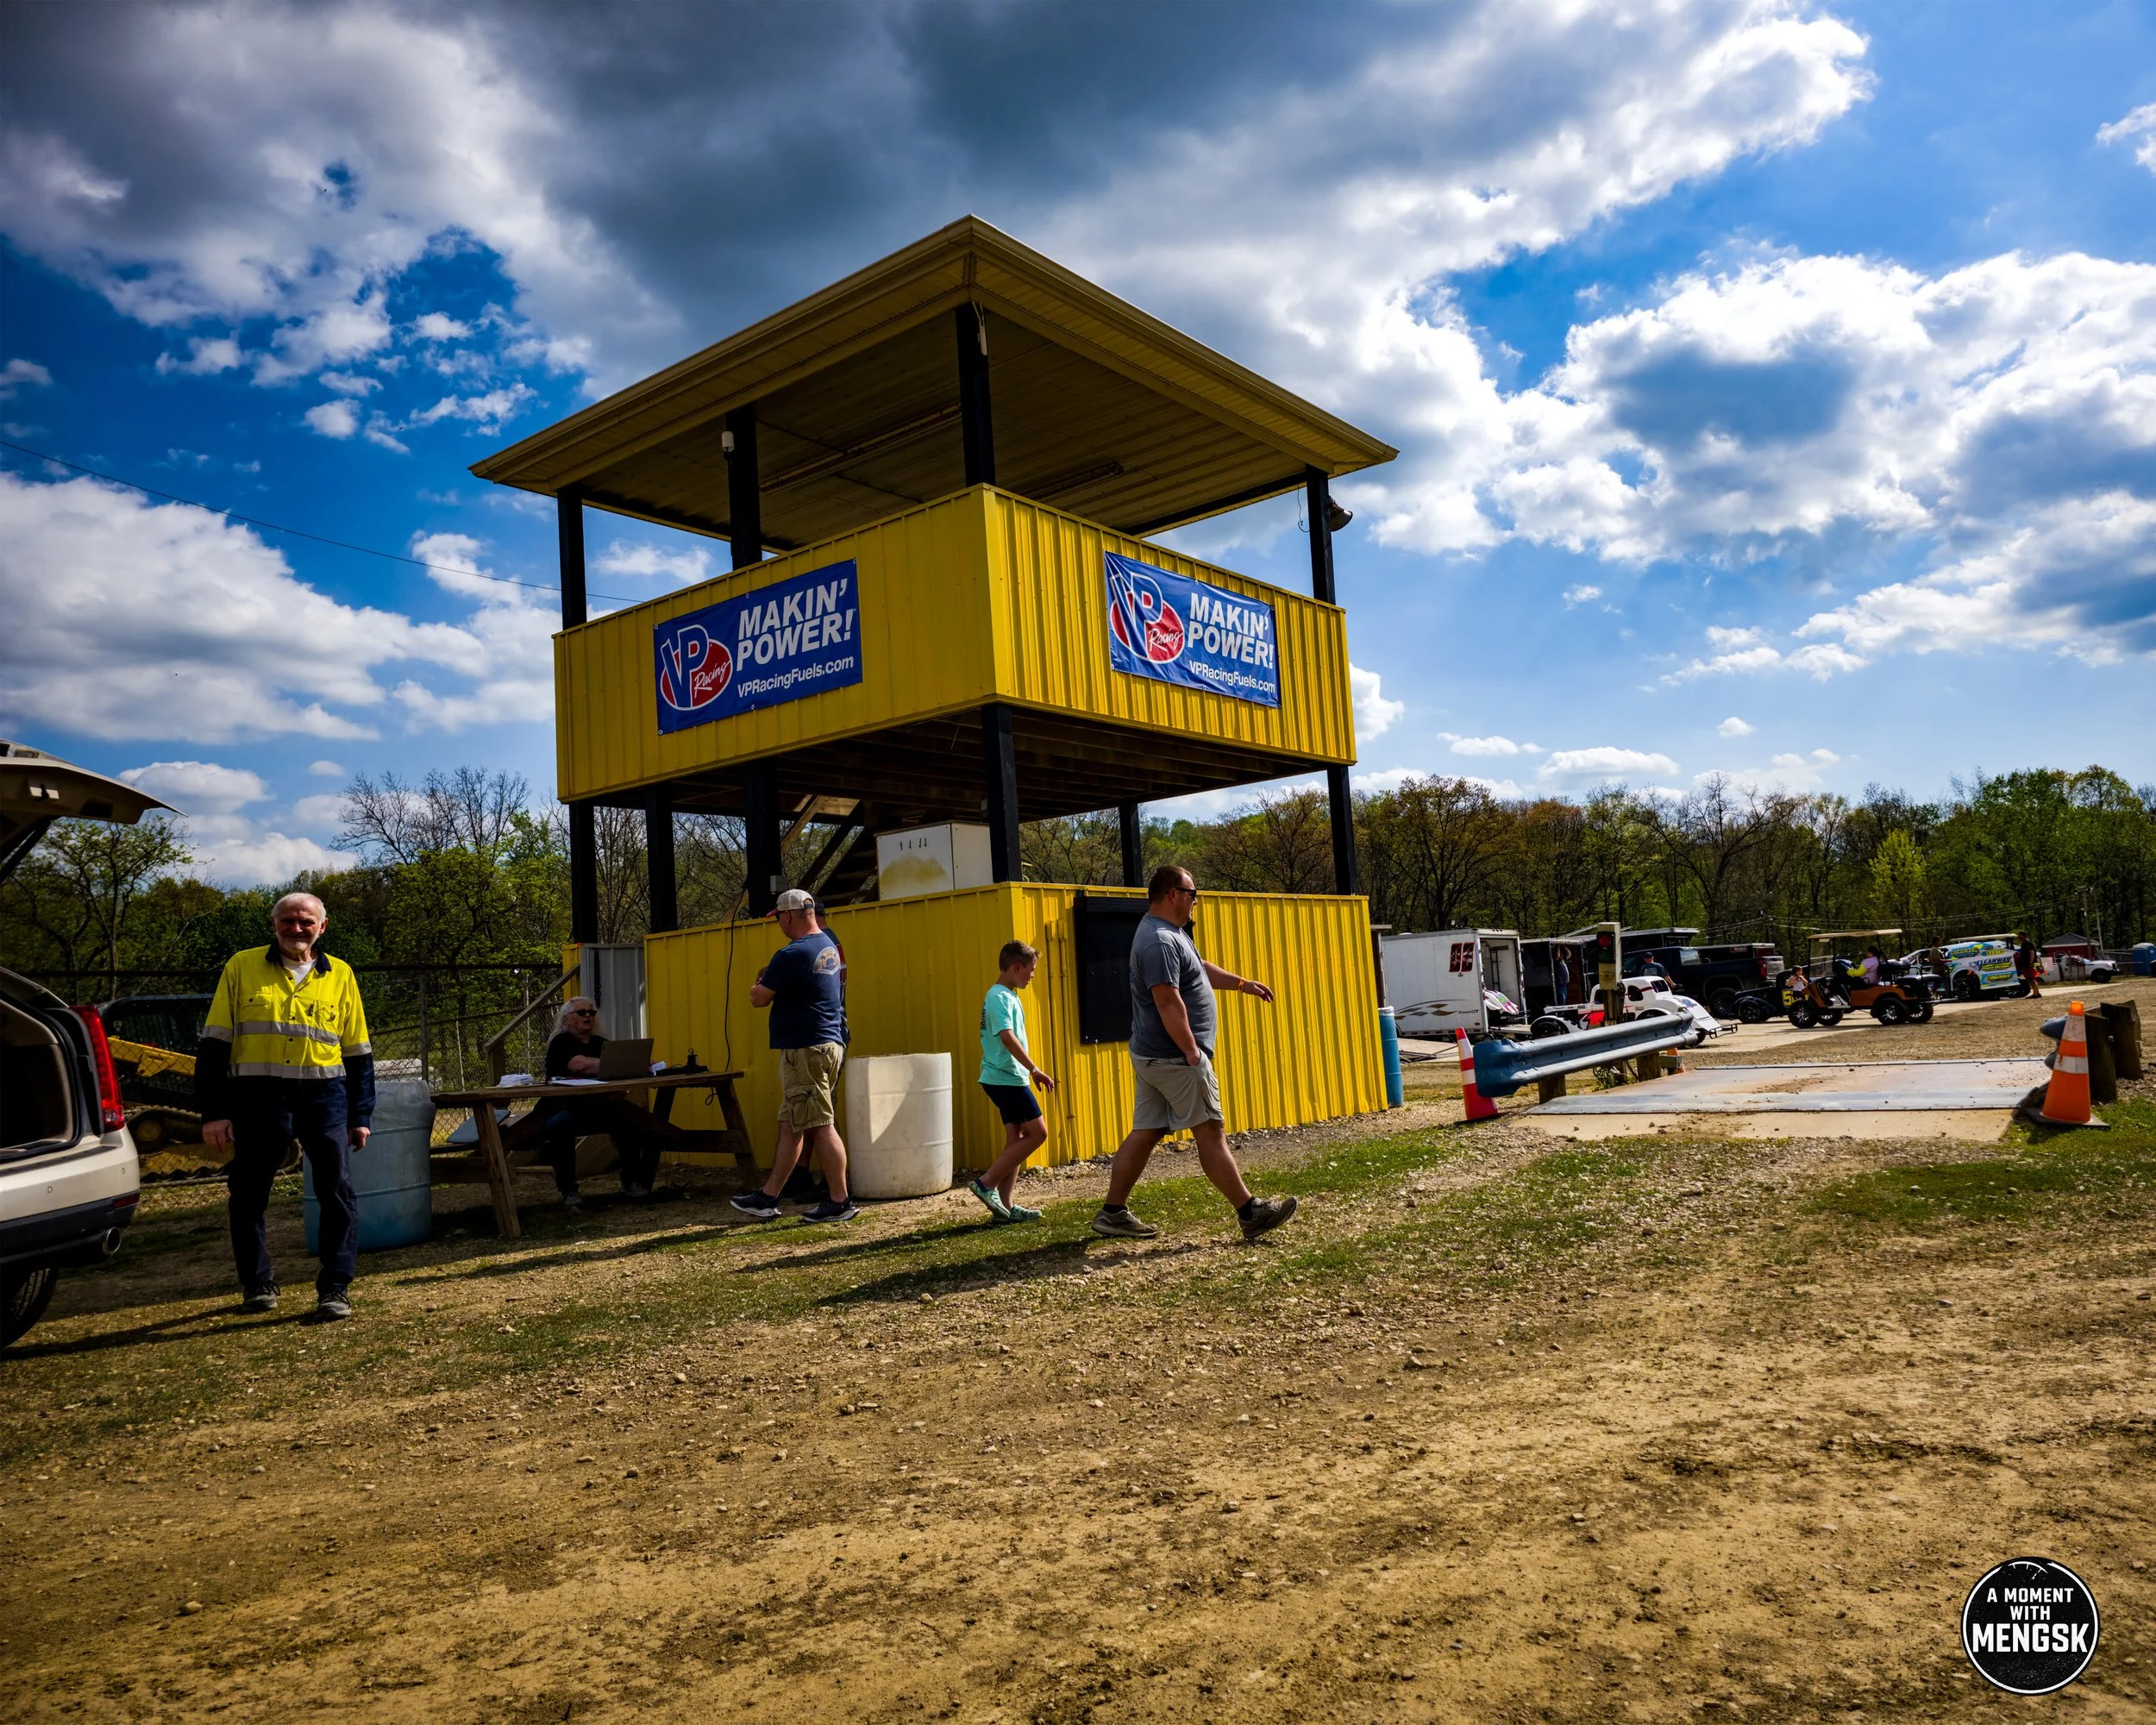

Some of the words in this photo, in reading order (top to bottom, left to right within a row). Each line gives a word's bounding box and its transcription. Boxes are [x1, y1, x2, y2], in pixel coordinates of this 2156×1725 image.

[738, 579, 848, 641] MAKIN'
[1109, 572, 1163, 661] VP
[1189, 593, 1269, 640] MAKIN'
[736, 609, 854, 672] POWER!
[1149, 628, 1184, 653] Racing
[1188, 621, 1275, 669] POWER!
[661, 624, 709, 708] VP
[693, 660, 731, 699] Racing
[737, 656, 854, 698] VPRacingFuels.com
[1189, 660, 1275, 693] VPRacingFuels.com
[1977, 956, 2013, 965] CLEANWAY
